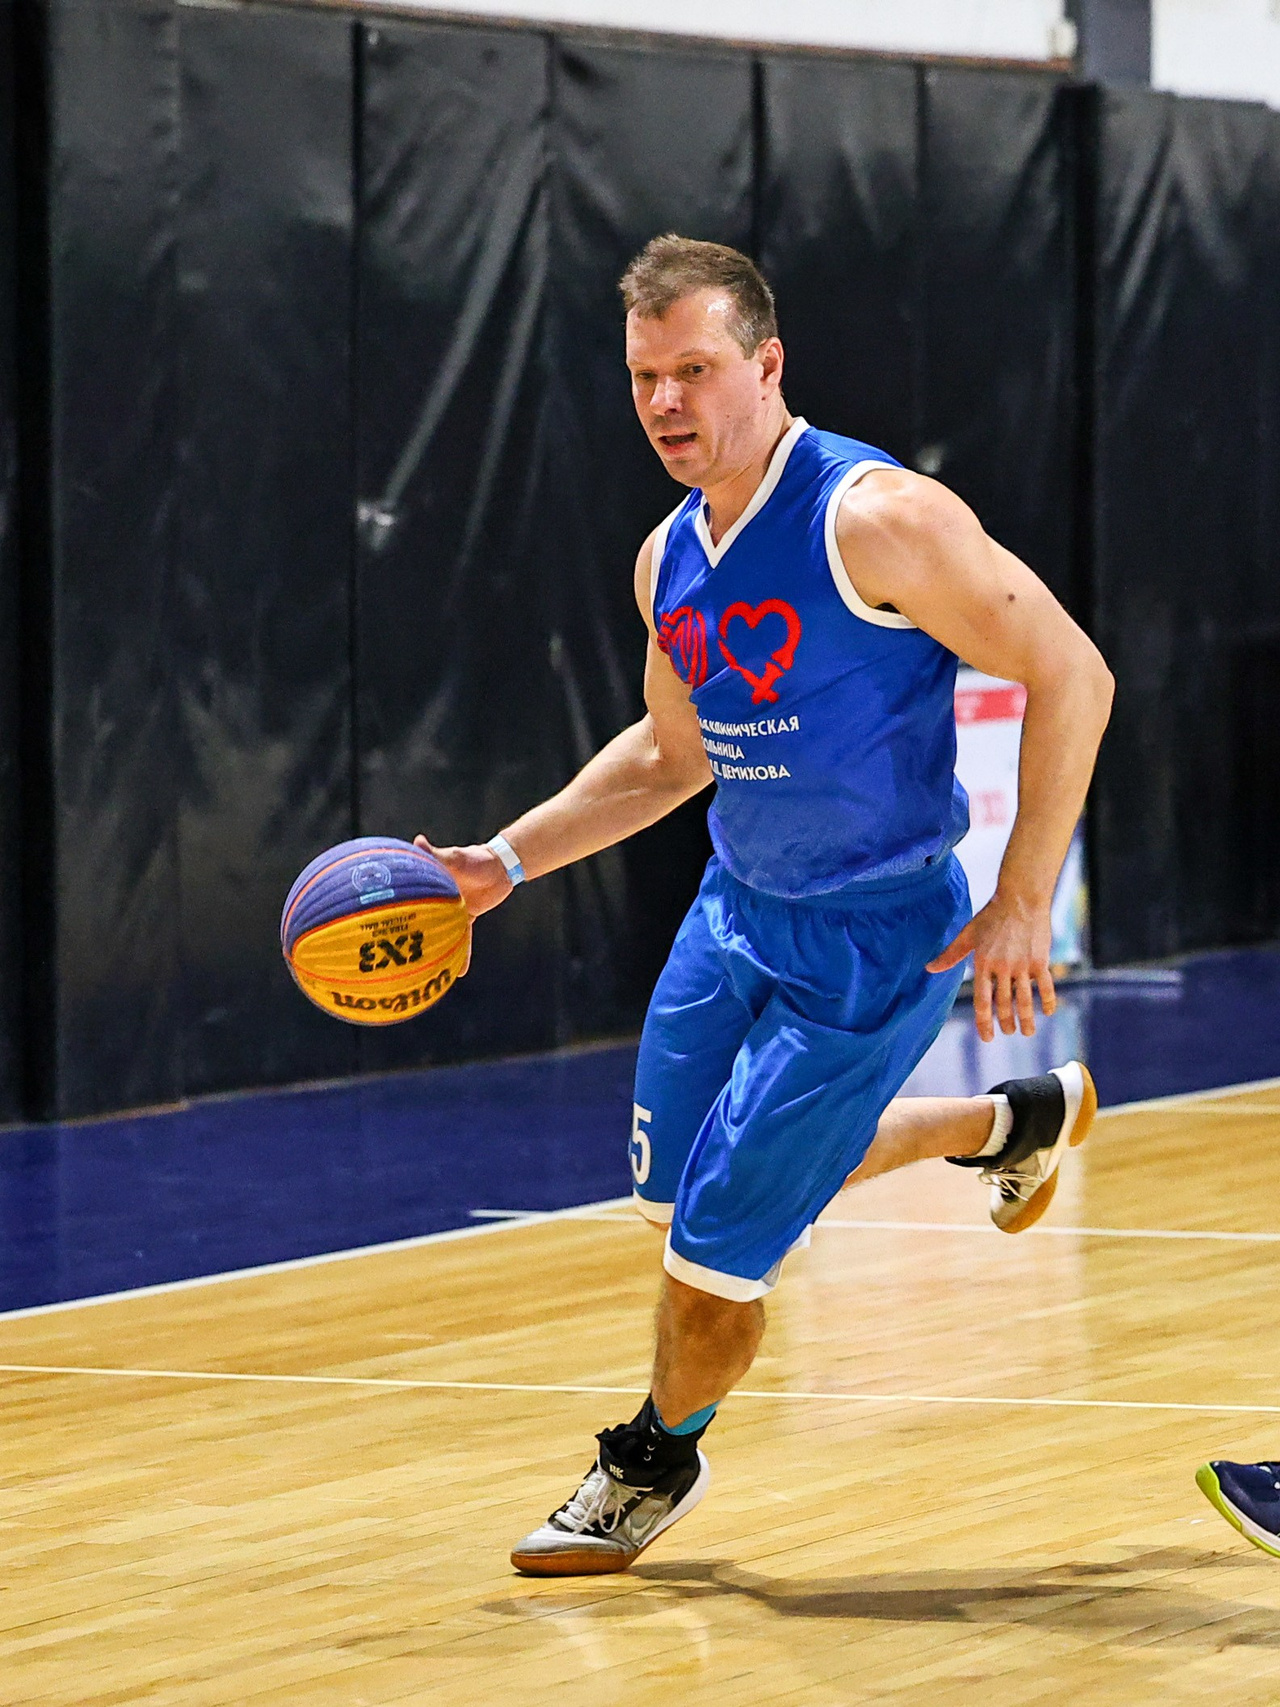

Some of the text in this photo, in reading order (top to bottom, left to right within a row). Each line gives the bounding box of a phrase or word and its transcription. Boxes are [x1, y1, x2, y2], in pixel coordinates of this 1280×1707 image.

[708, 715, 800, 737] КЛИНИЧЕСКАЯ
[701, 735, 745, 760] ОЛЬНИЦА
[631, 1102, 652, 1185] 5
